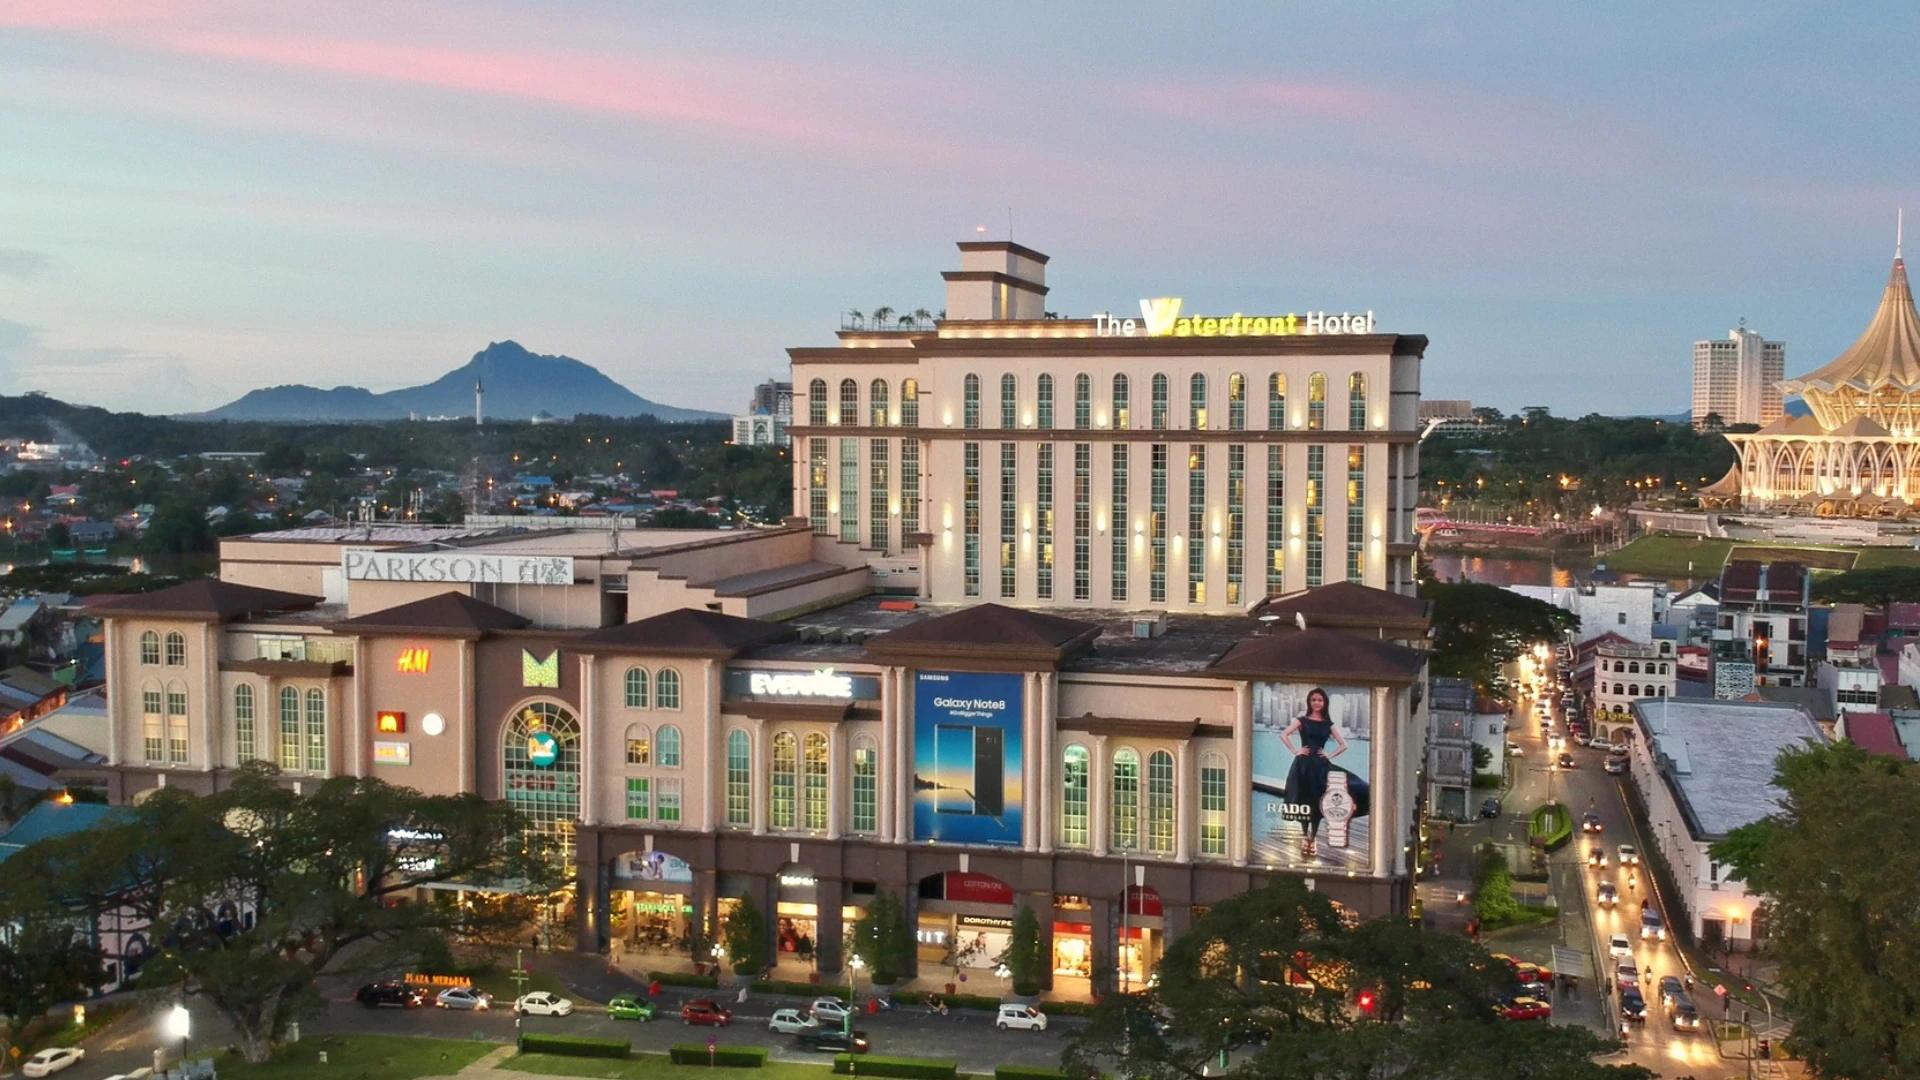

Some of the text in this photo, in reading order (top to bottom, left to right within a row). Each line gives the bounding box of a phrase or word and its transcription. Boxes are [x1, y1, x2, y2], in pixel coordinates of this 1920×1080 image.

[1092, 297, 1374, 337] The Waterfront Hotel
[345, 551, 502, 582] PARKSON
[396, 648, 431, 674] H&M
[933, 697, 1006, 710] Galaxy Note8
[1266, 802, 1311, 815] RADO
[963, 916, 1001, 926] DOROTHY
[404, 972, 430, 984] PLAZA
